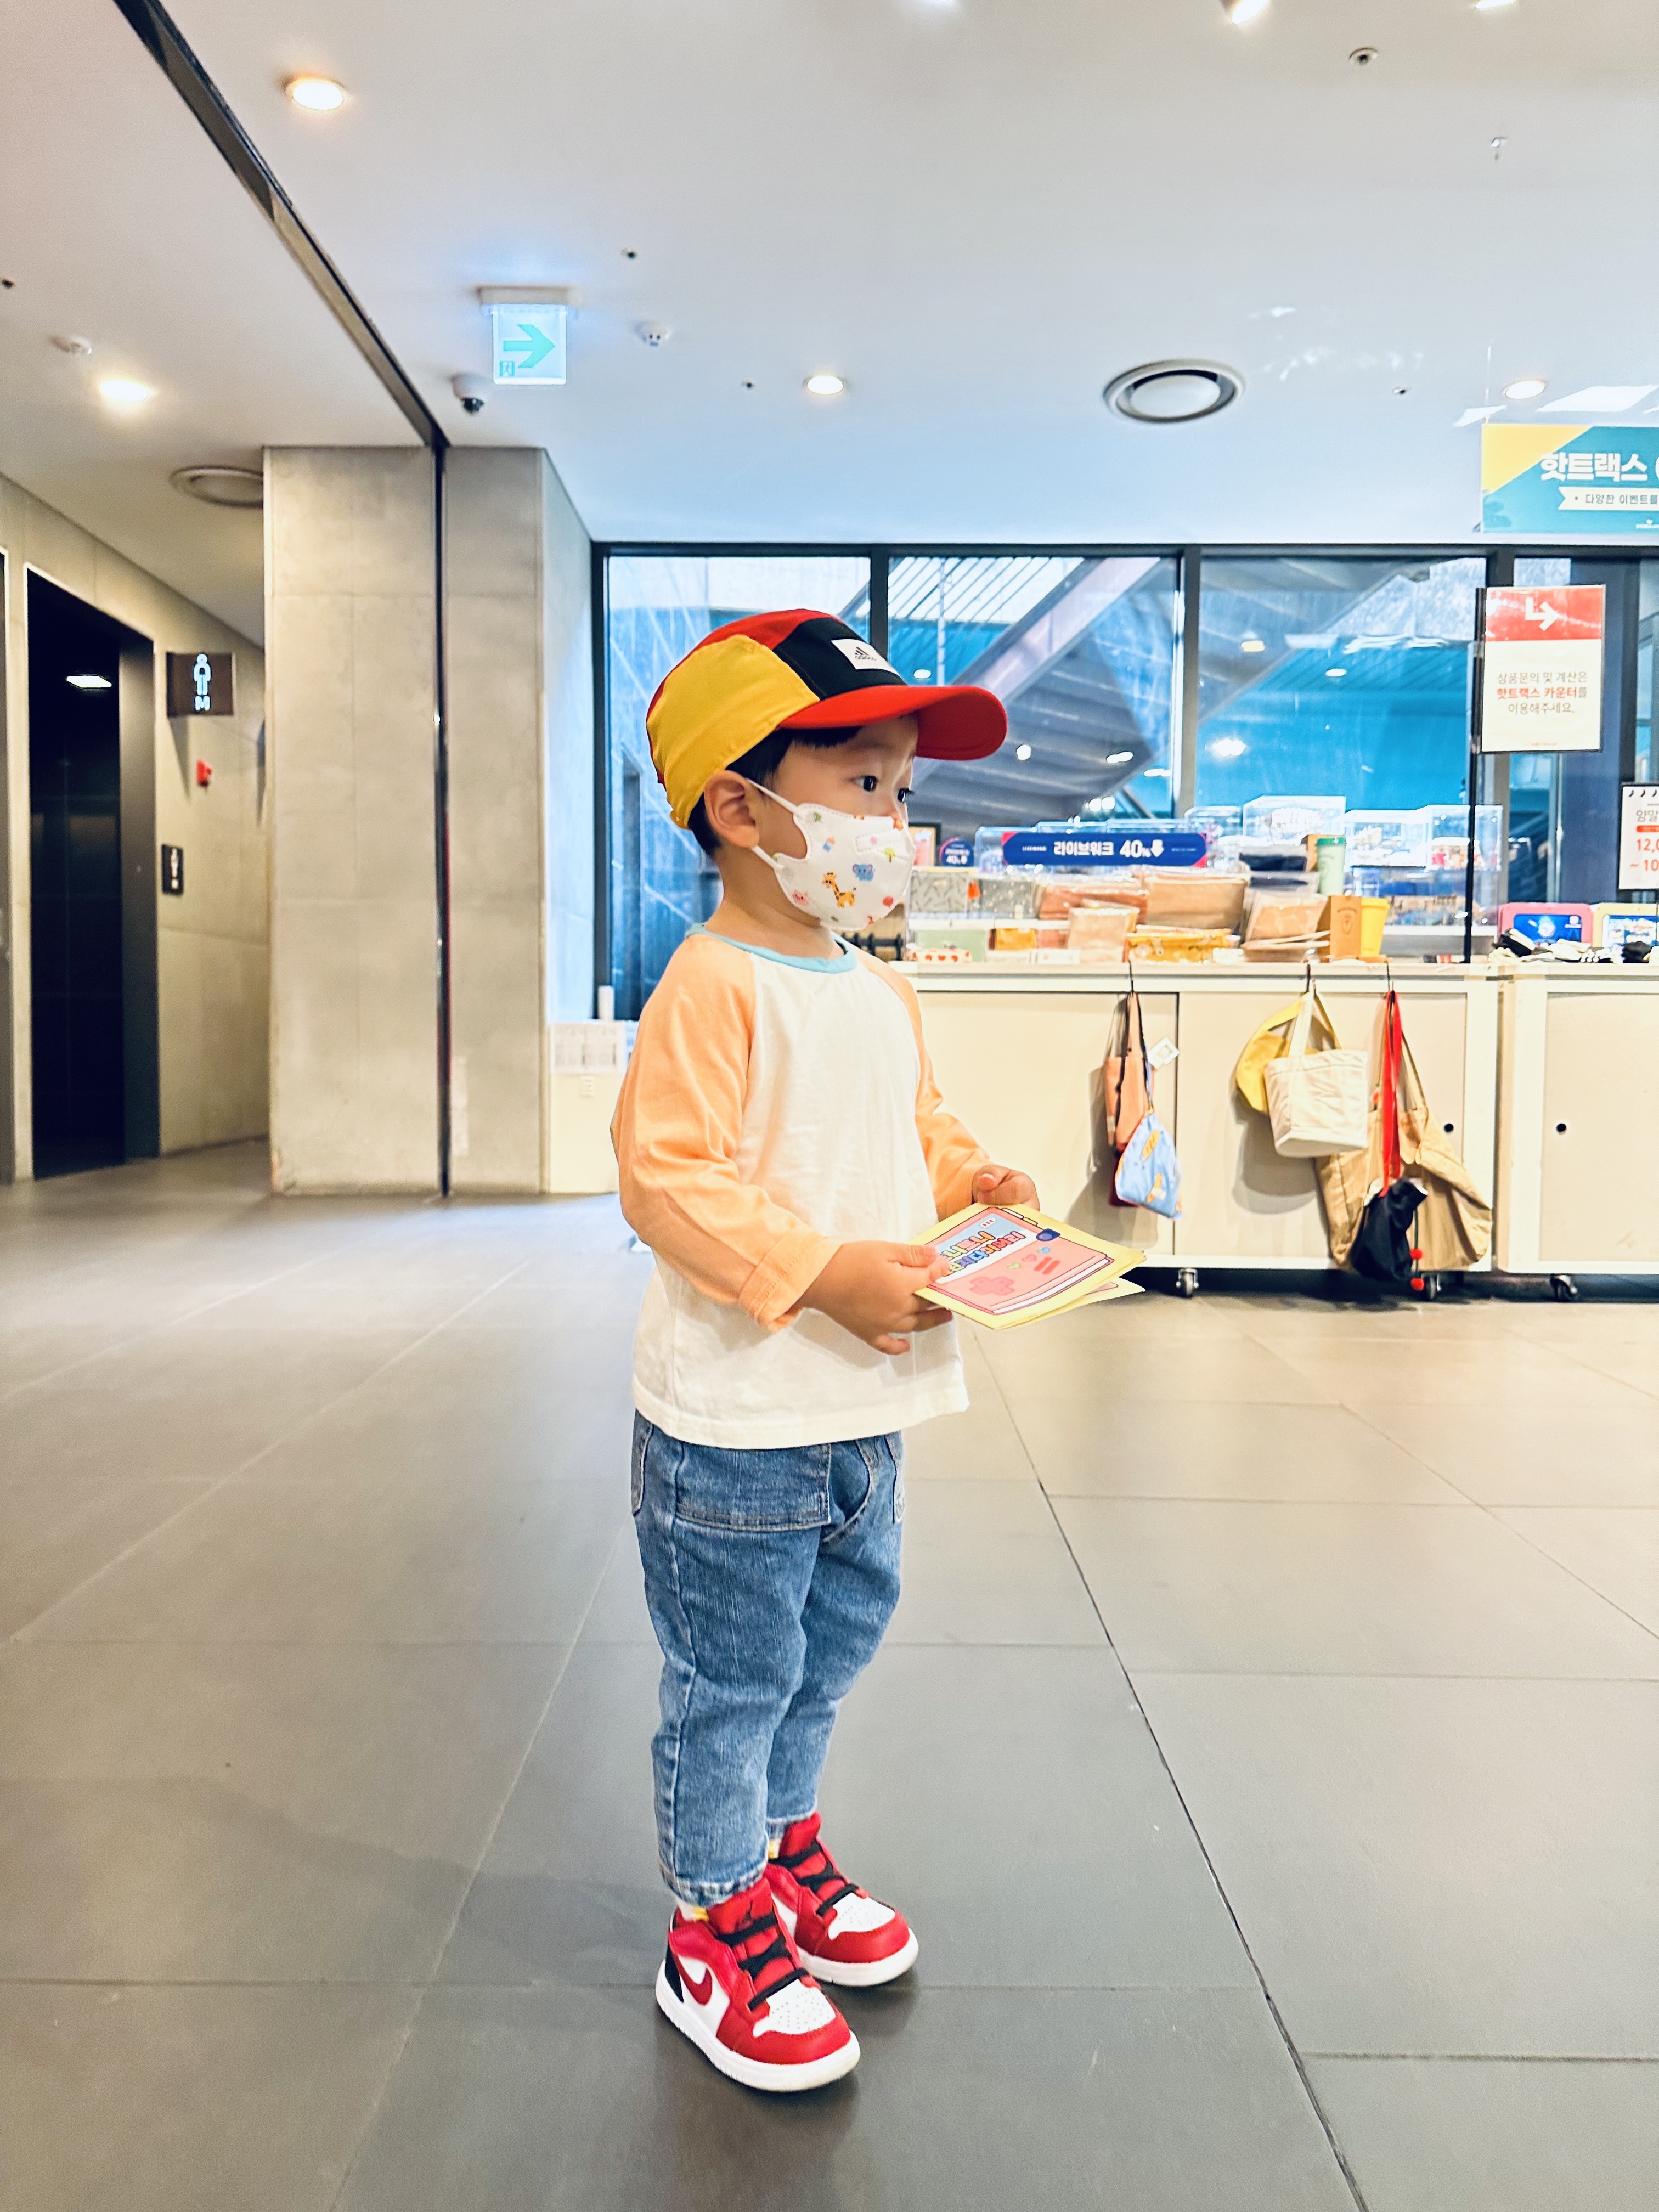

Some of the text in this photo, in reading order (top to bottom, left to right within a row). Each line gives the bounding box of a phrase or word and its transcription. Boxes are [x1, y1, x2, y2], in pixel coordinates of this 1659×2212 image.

[1541, 452, 1648, 482] 핫트랙스
[1585, 494, 1658, 505] 다양한 이벤트를
[1497, 672, 1588, 685] 상품문의 및 계산은
[1496, 686, 1587, 700] 핫트랙스 카운터를
[195, 695, 210, 711] M
[1508, 702, 1575, 715] 이용해주세요.
[1053, 839, 1152, 859] 라이브워크 40%
[939, 1231, 996, 1261] 니트니
